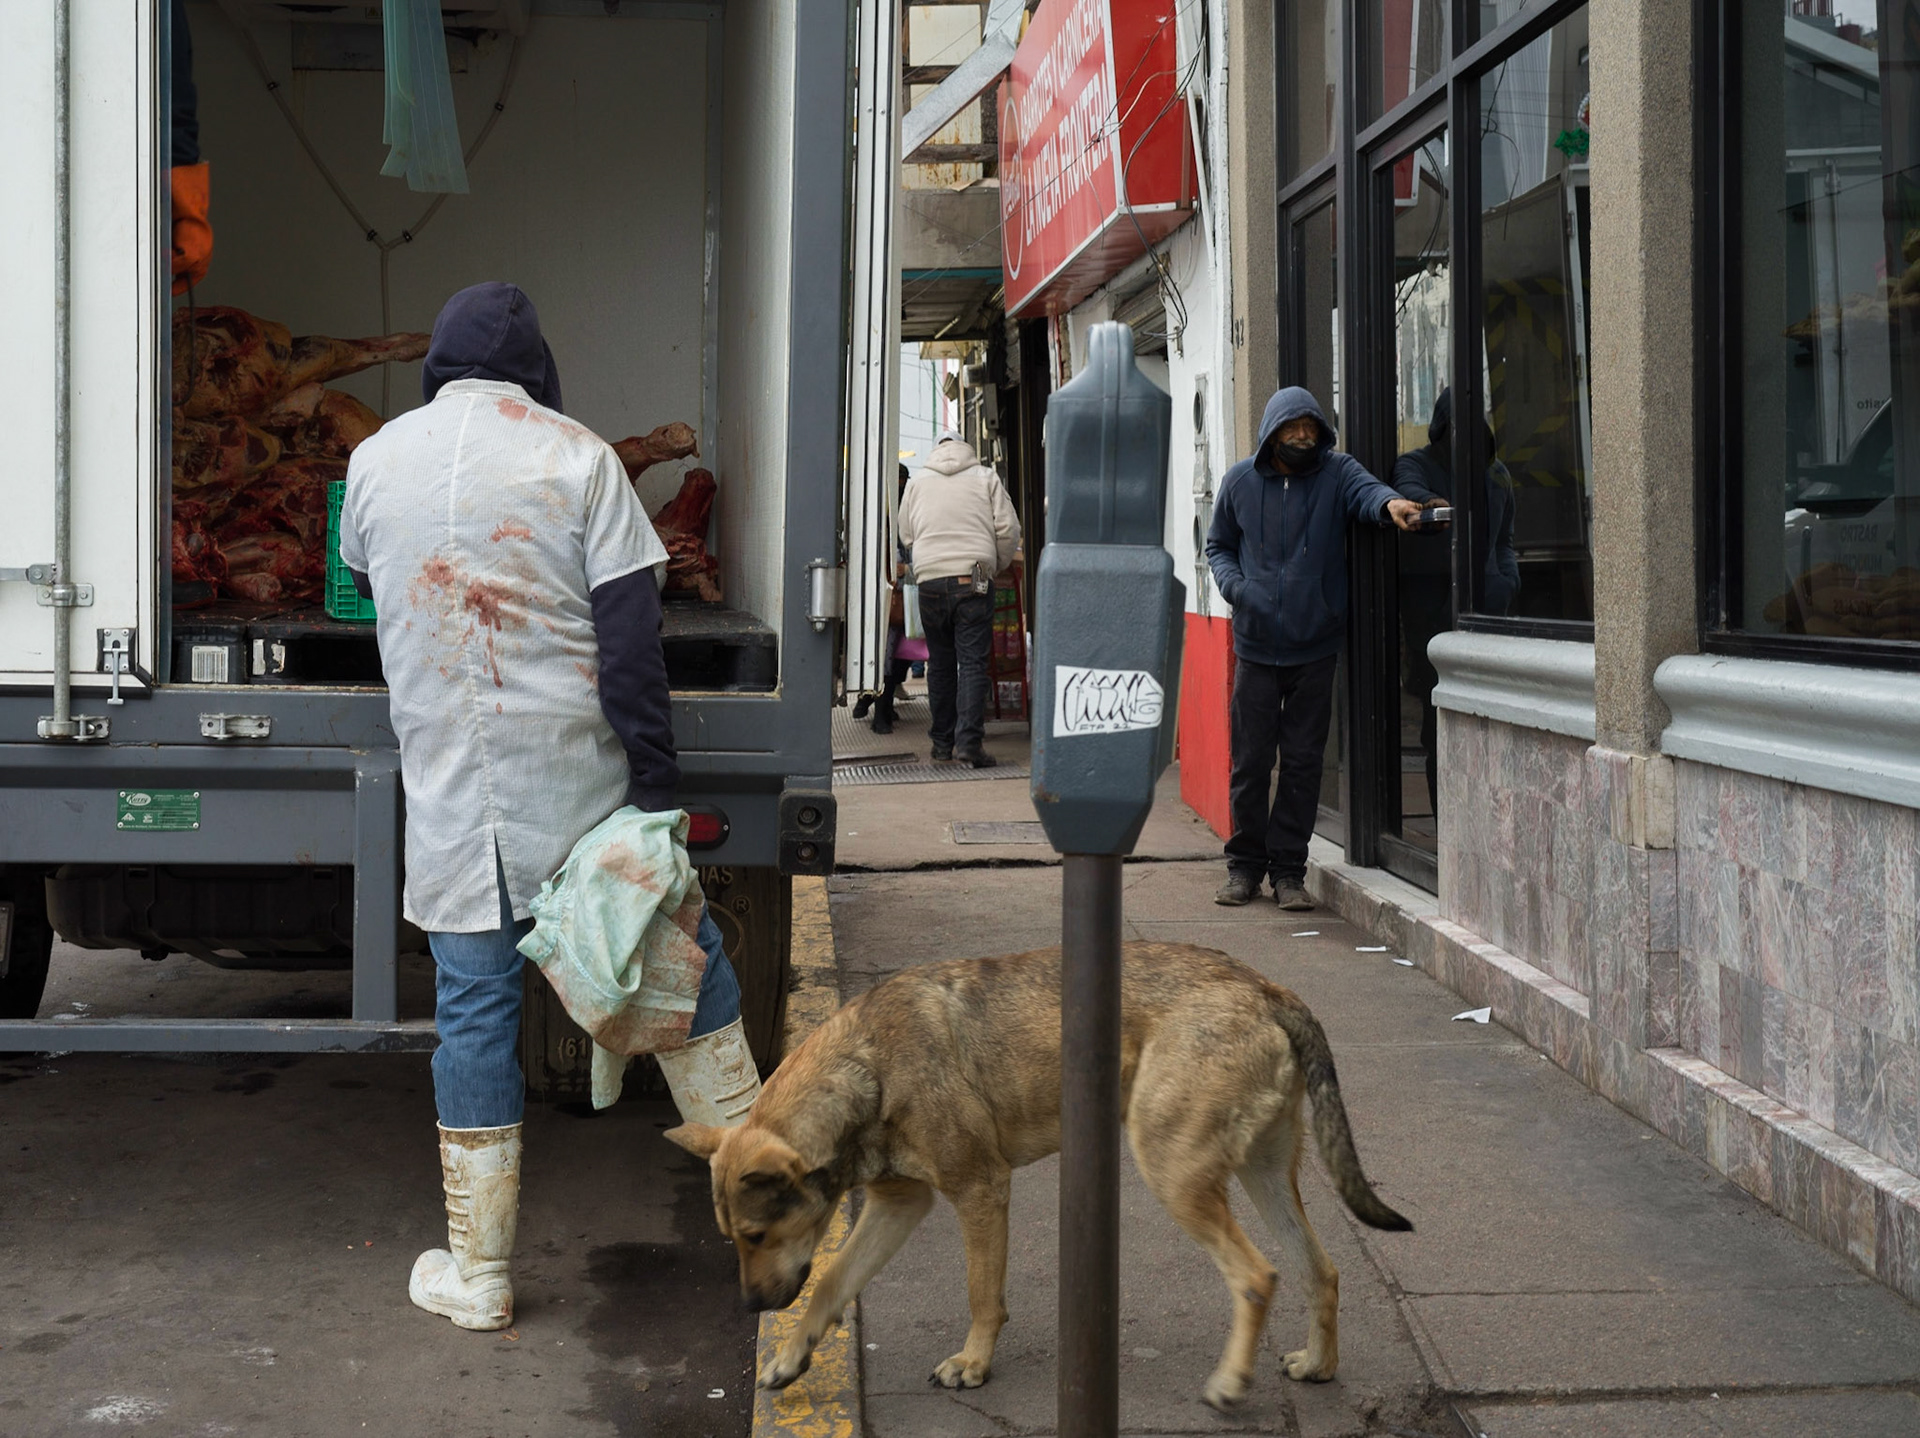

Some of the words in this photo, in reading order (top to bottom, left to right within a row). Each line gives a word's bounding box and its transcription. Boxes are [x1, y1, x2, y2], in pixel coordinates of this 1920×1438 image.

[1020, 51, 1053, 148] ABARROTES
[1050, 40, 1058, 98] Y
[1023, 167, 1036, 246] LA
[1033, 132, 1062, 238] NUEVA
[1059, 63, 1114, 205] FRONTERA
[558, 1037, 588, 1064] (61
